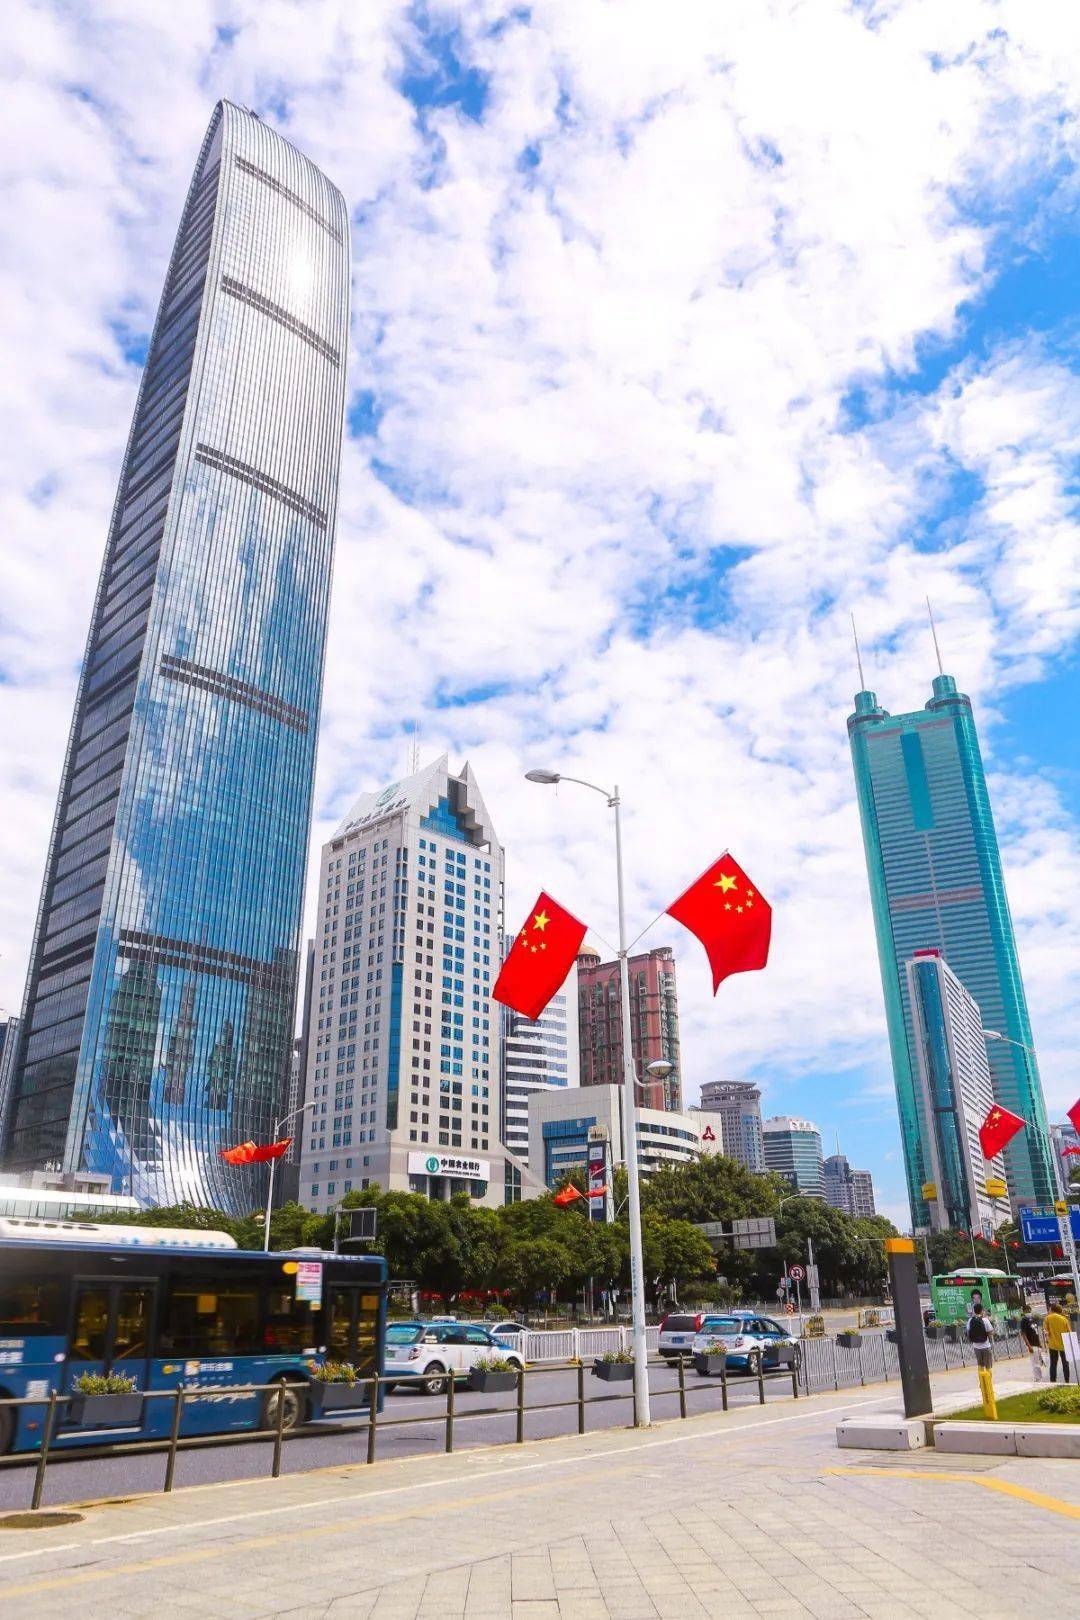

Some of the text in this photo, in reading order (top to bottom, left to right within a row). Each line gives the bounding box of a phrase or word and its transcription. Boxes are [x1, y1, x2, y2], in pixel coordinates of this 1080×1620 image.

[440, 1158, 480, 1171] 中国农业银行
